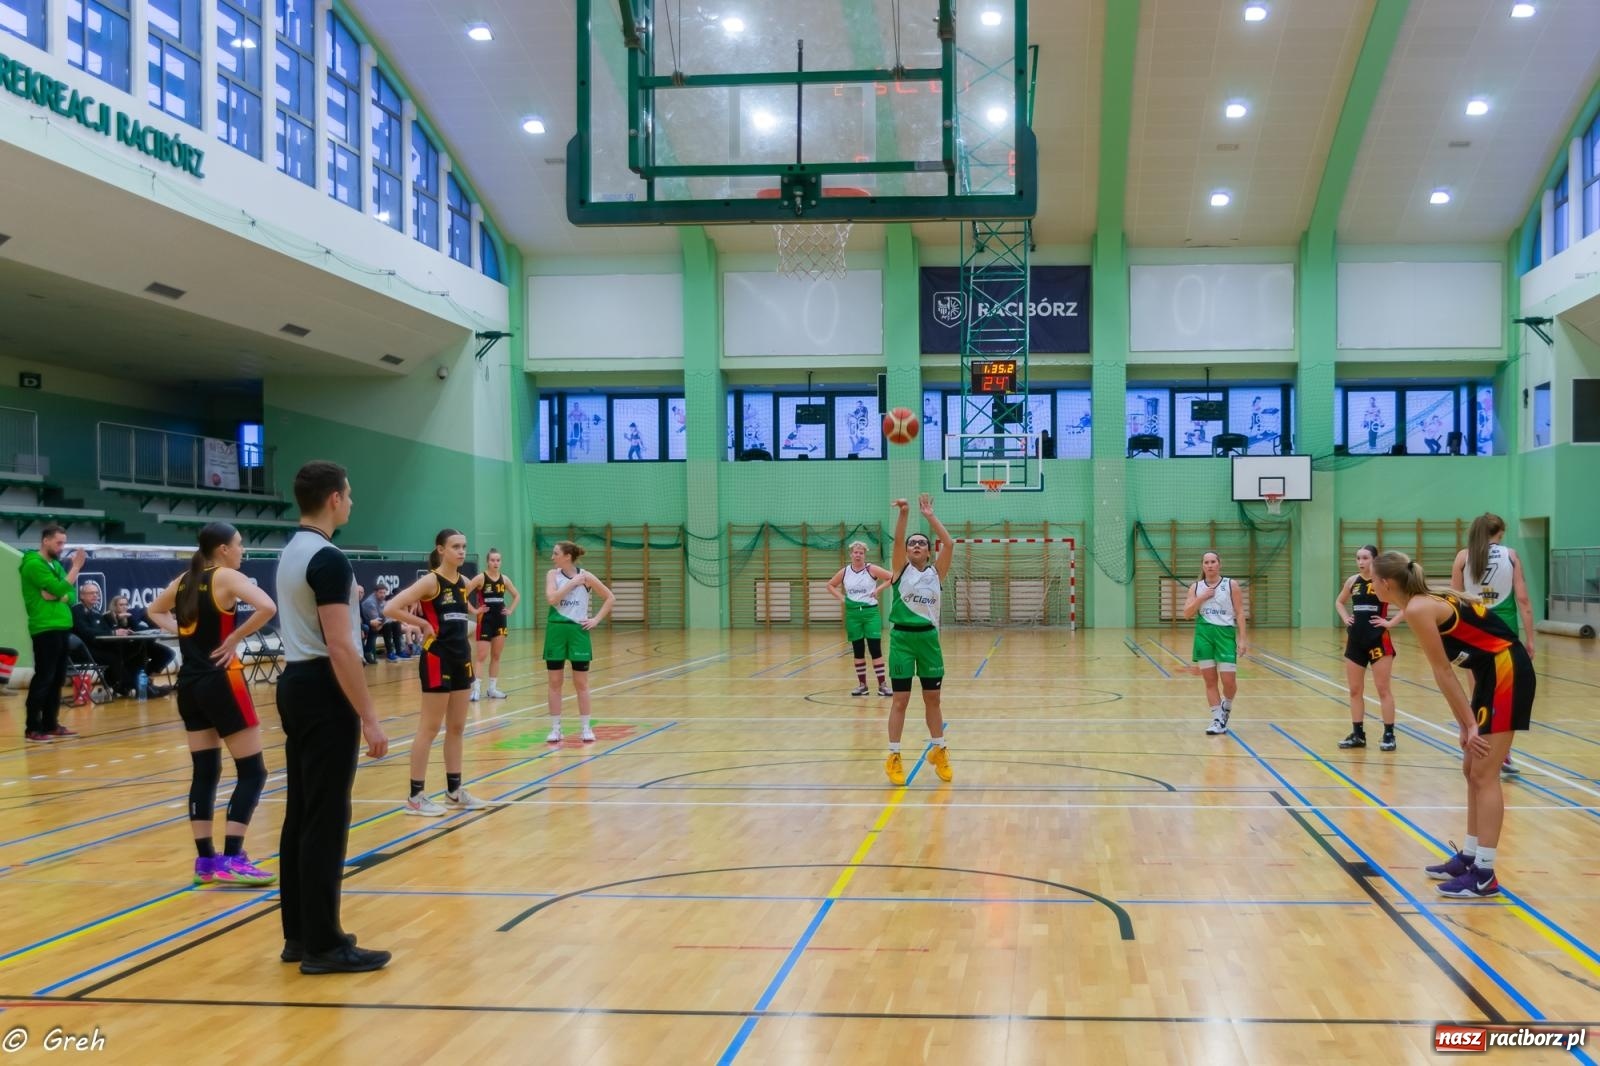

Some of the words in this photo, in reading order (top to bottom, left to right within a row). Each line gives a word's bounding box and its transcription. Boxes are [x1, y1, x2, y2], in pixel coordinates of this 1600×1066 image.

[0, 54, 111, 136] REKREACJI
[116, 111, 205, 179] RACIBÓRZ
[983, 376, 1005, 391] 24
[1369, 647, 1384, 660] 13
